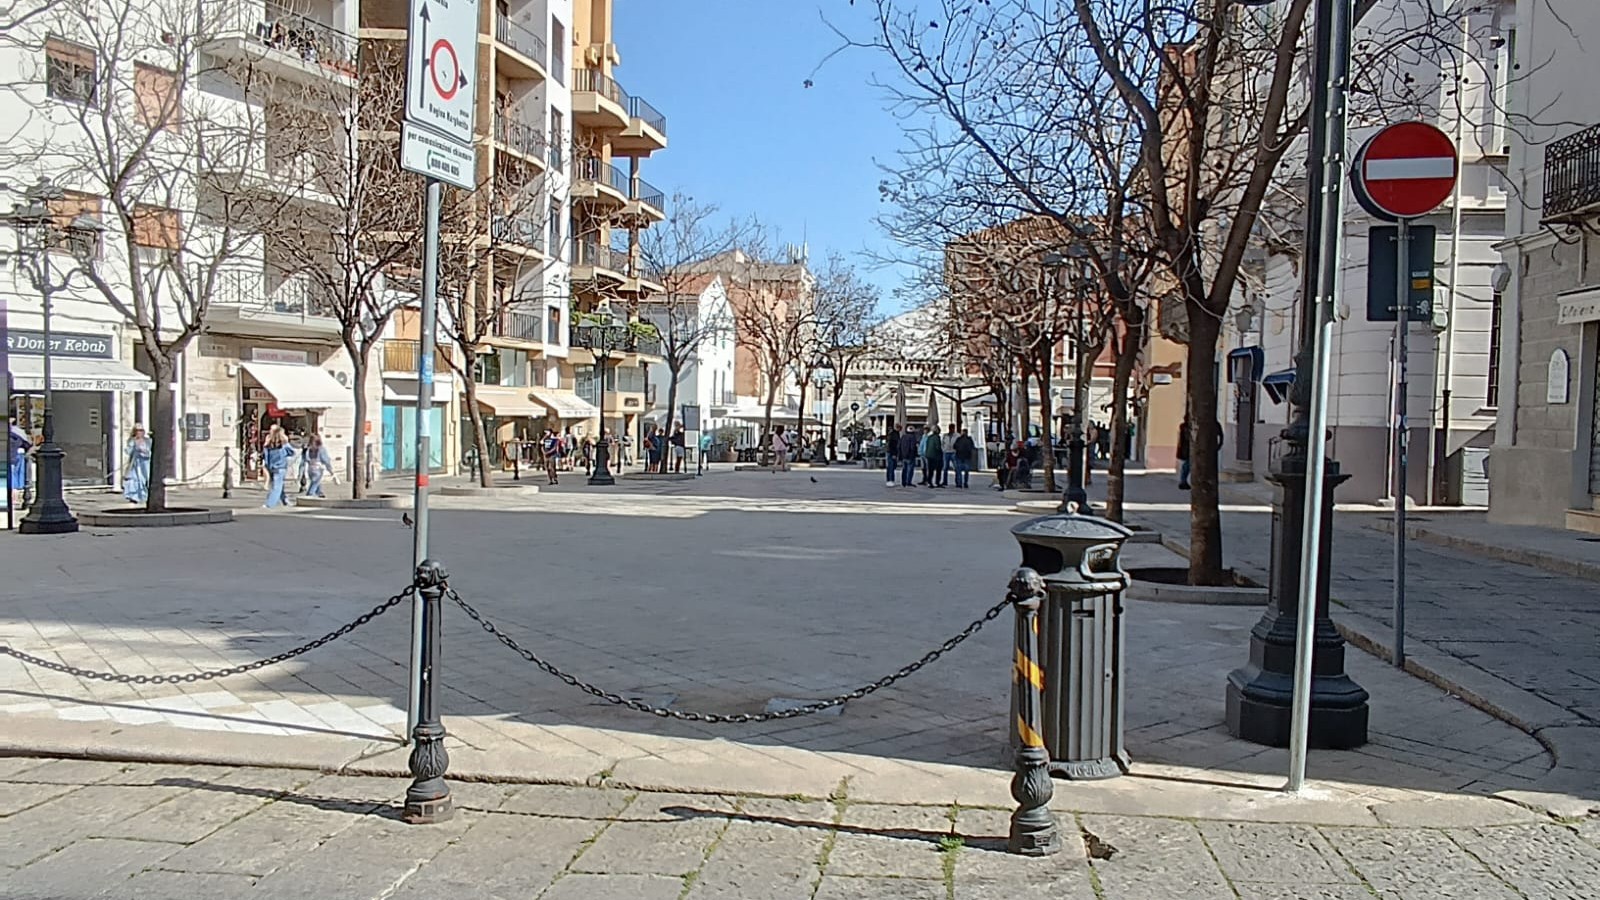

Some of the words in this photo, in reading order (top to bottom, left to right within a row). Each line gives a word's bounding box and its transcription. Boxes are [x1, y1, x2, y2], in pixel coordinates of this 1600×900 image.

[17, 336, 61, 350] Doner
[64, 338, 106, 353] Kebab
[61, 379, 93, 389] Doner
[95, 380, 126, 390] Kebab
